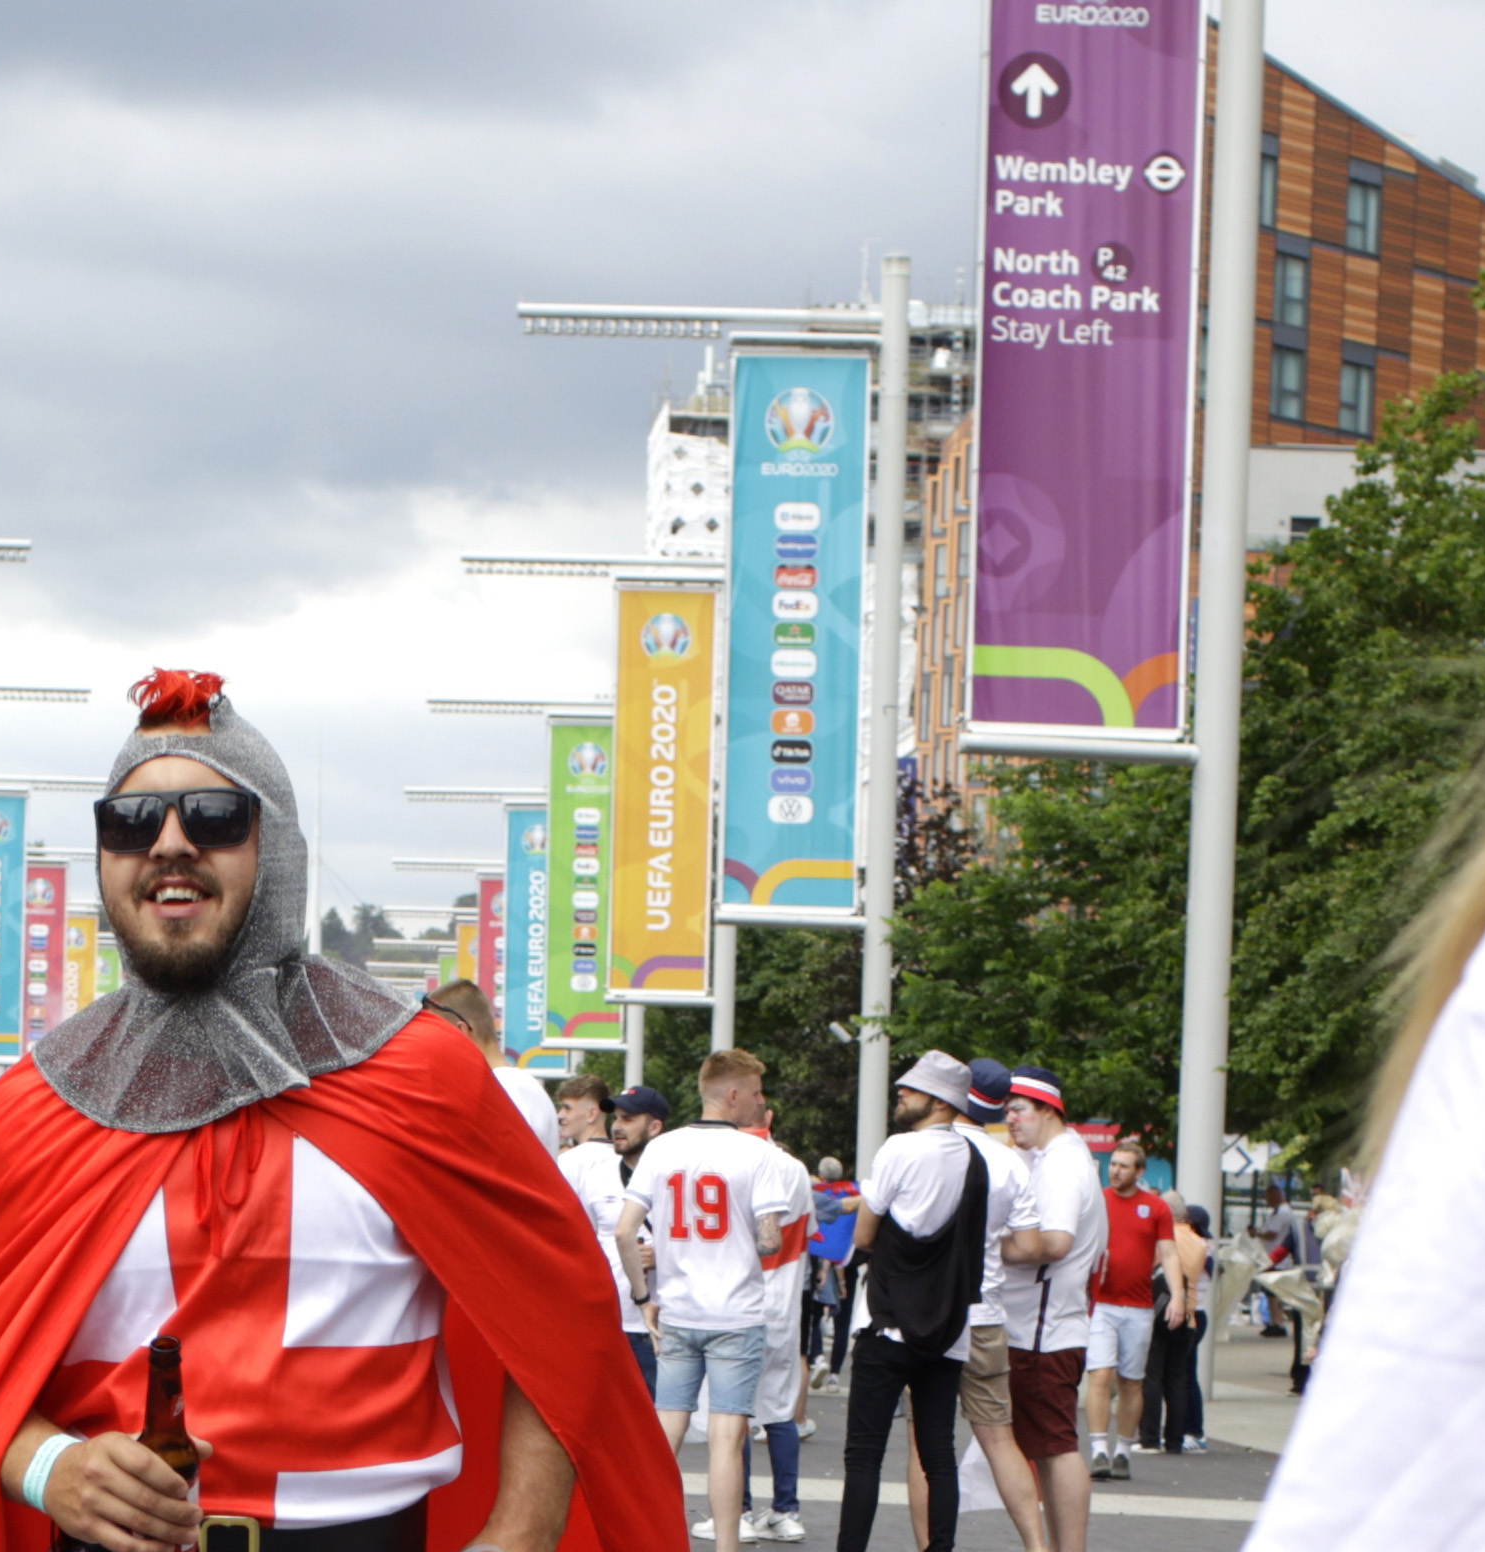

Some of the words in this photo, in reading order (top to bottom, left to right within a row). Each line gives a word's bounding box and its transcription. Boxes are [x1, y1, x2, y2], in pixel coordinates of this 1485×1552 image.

[995, 154, 1134, 192] Wembley
[994, 189, 1064, 218] Park
[993, 247, 1080, 276] North
[1097, 247, 1114, 268] P
[1102, 264, 1128, 282] 42
[991, 281, 1082, 311] Coach
[1090, 284, 1161, 313] Park
[990, 315, 1052, 350] Stay
[1058, 318, 1114, 347] Left
[650, 683, 678, 762] 2020
[647, 764, 676, 848] EURO
[529, 870, 546, 921] 2020
[645, 851, 673, 931] UEFA
[528, 921, 545, 977] EURO
[527, 977, 543, 1032] UEFA
[666, 1170, 731, 1243] 19
